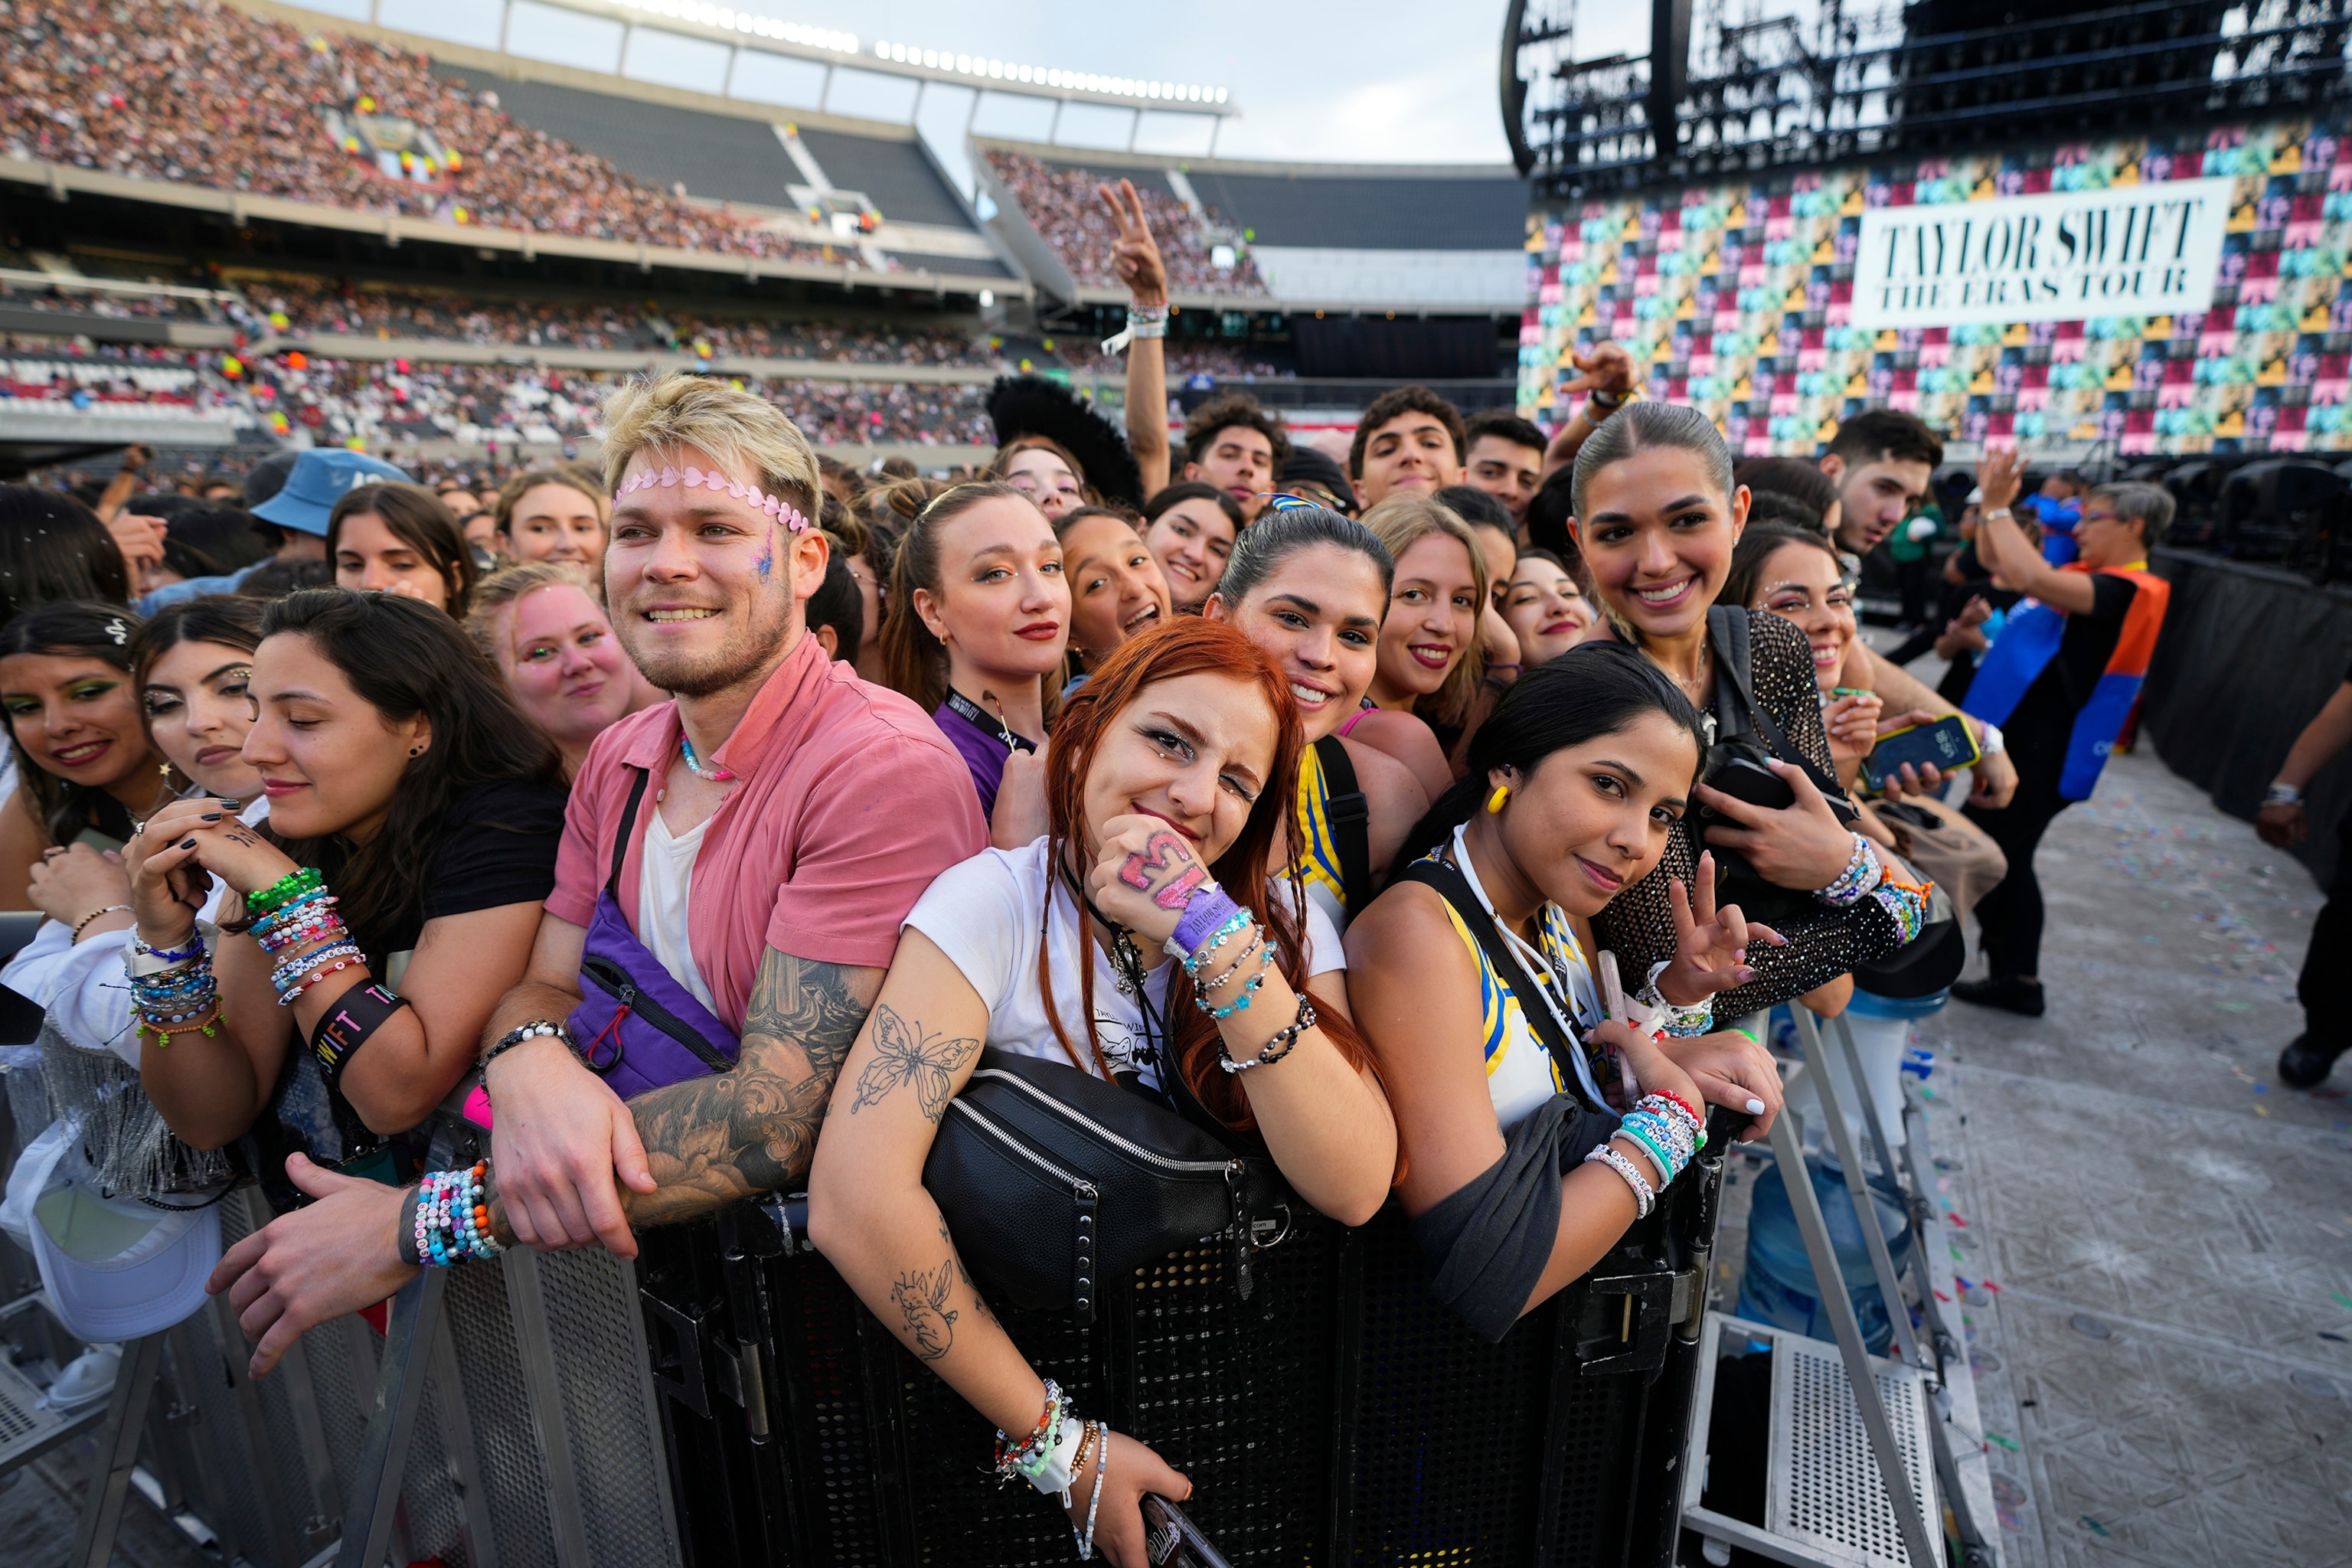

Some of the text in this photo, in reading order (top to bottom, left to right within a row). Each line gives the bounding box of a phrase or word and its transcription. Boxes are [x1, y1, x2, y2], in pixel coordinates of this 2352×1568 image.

[1880, 197, 2204, 279] TAYLOR SWIFT
[1875, 266, 2188, 312] THE ERAS TOUR
[1117, 829, 1208, 911] 13
[293, 946, 356, 975] PROBLEMS
[365, 984, 399, 1004] TA
[316, 1010, 362, 1074] SWIFT
[1646, 1129, 1668, 1149] THE
[1613, 1151, 1650, 1193] ISSING
[416, 1203, 430, 1258] SUMMER
